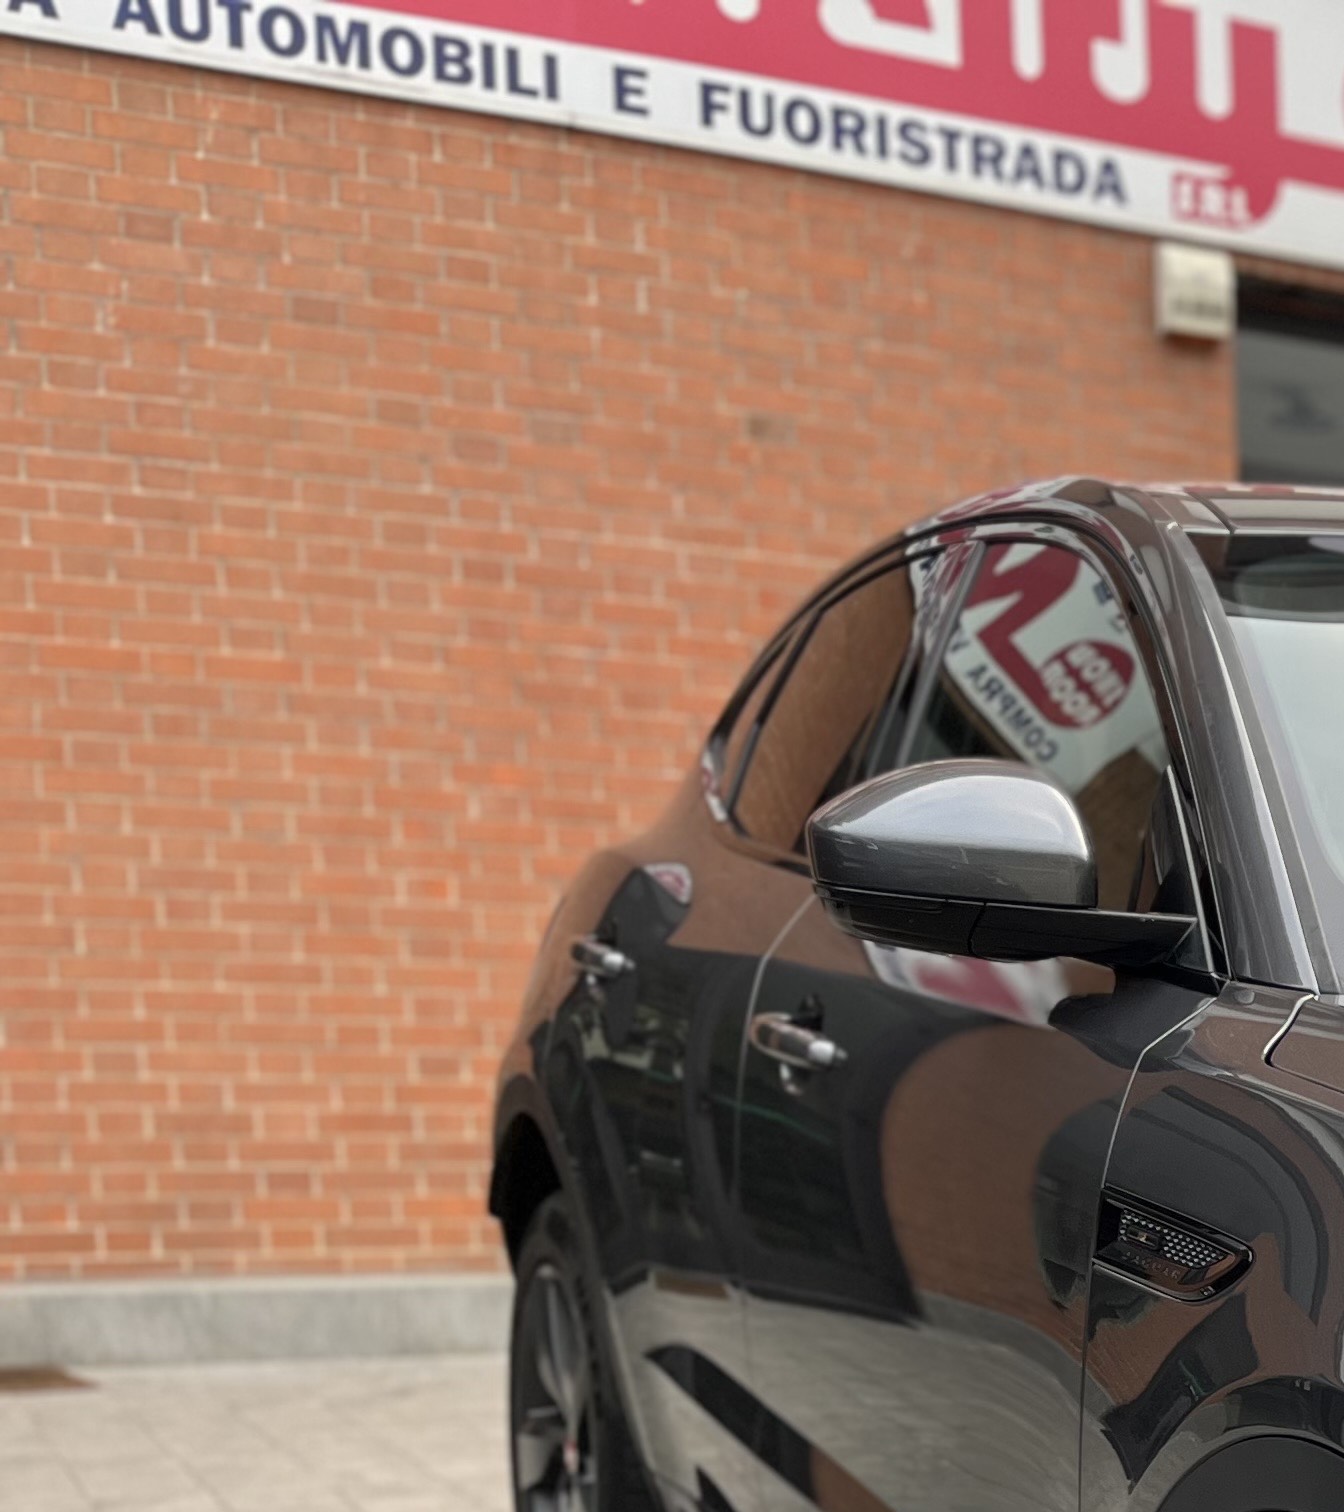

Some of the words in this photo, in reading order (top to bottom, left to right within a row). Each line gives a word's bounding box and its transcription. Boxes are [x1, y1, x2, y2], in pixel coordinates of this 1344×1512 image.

[113, 0, 559, 101] AUTOMOBILI
[612, 65, 651, 117] E
[698, 81, 1129, 206] FUORISTRADA
